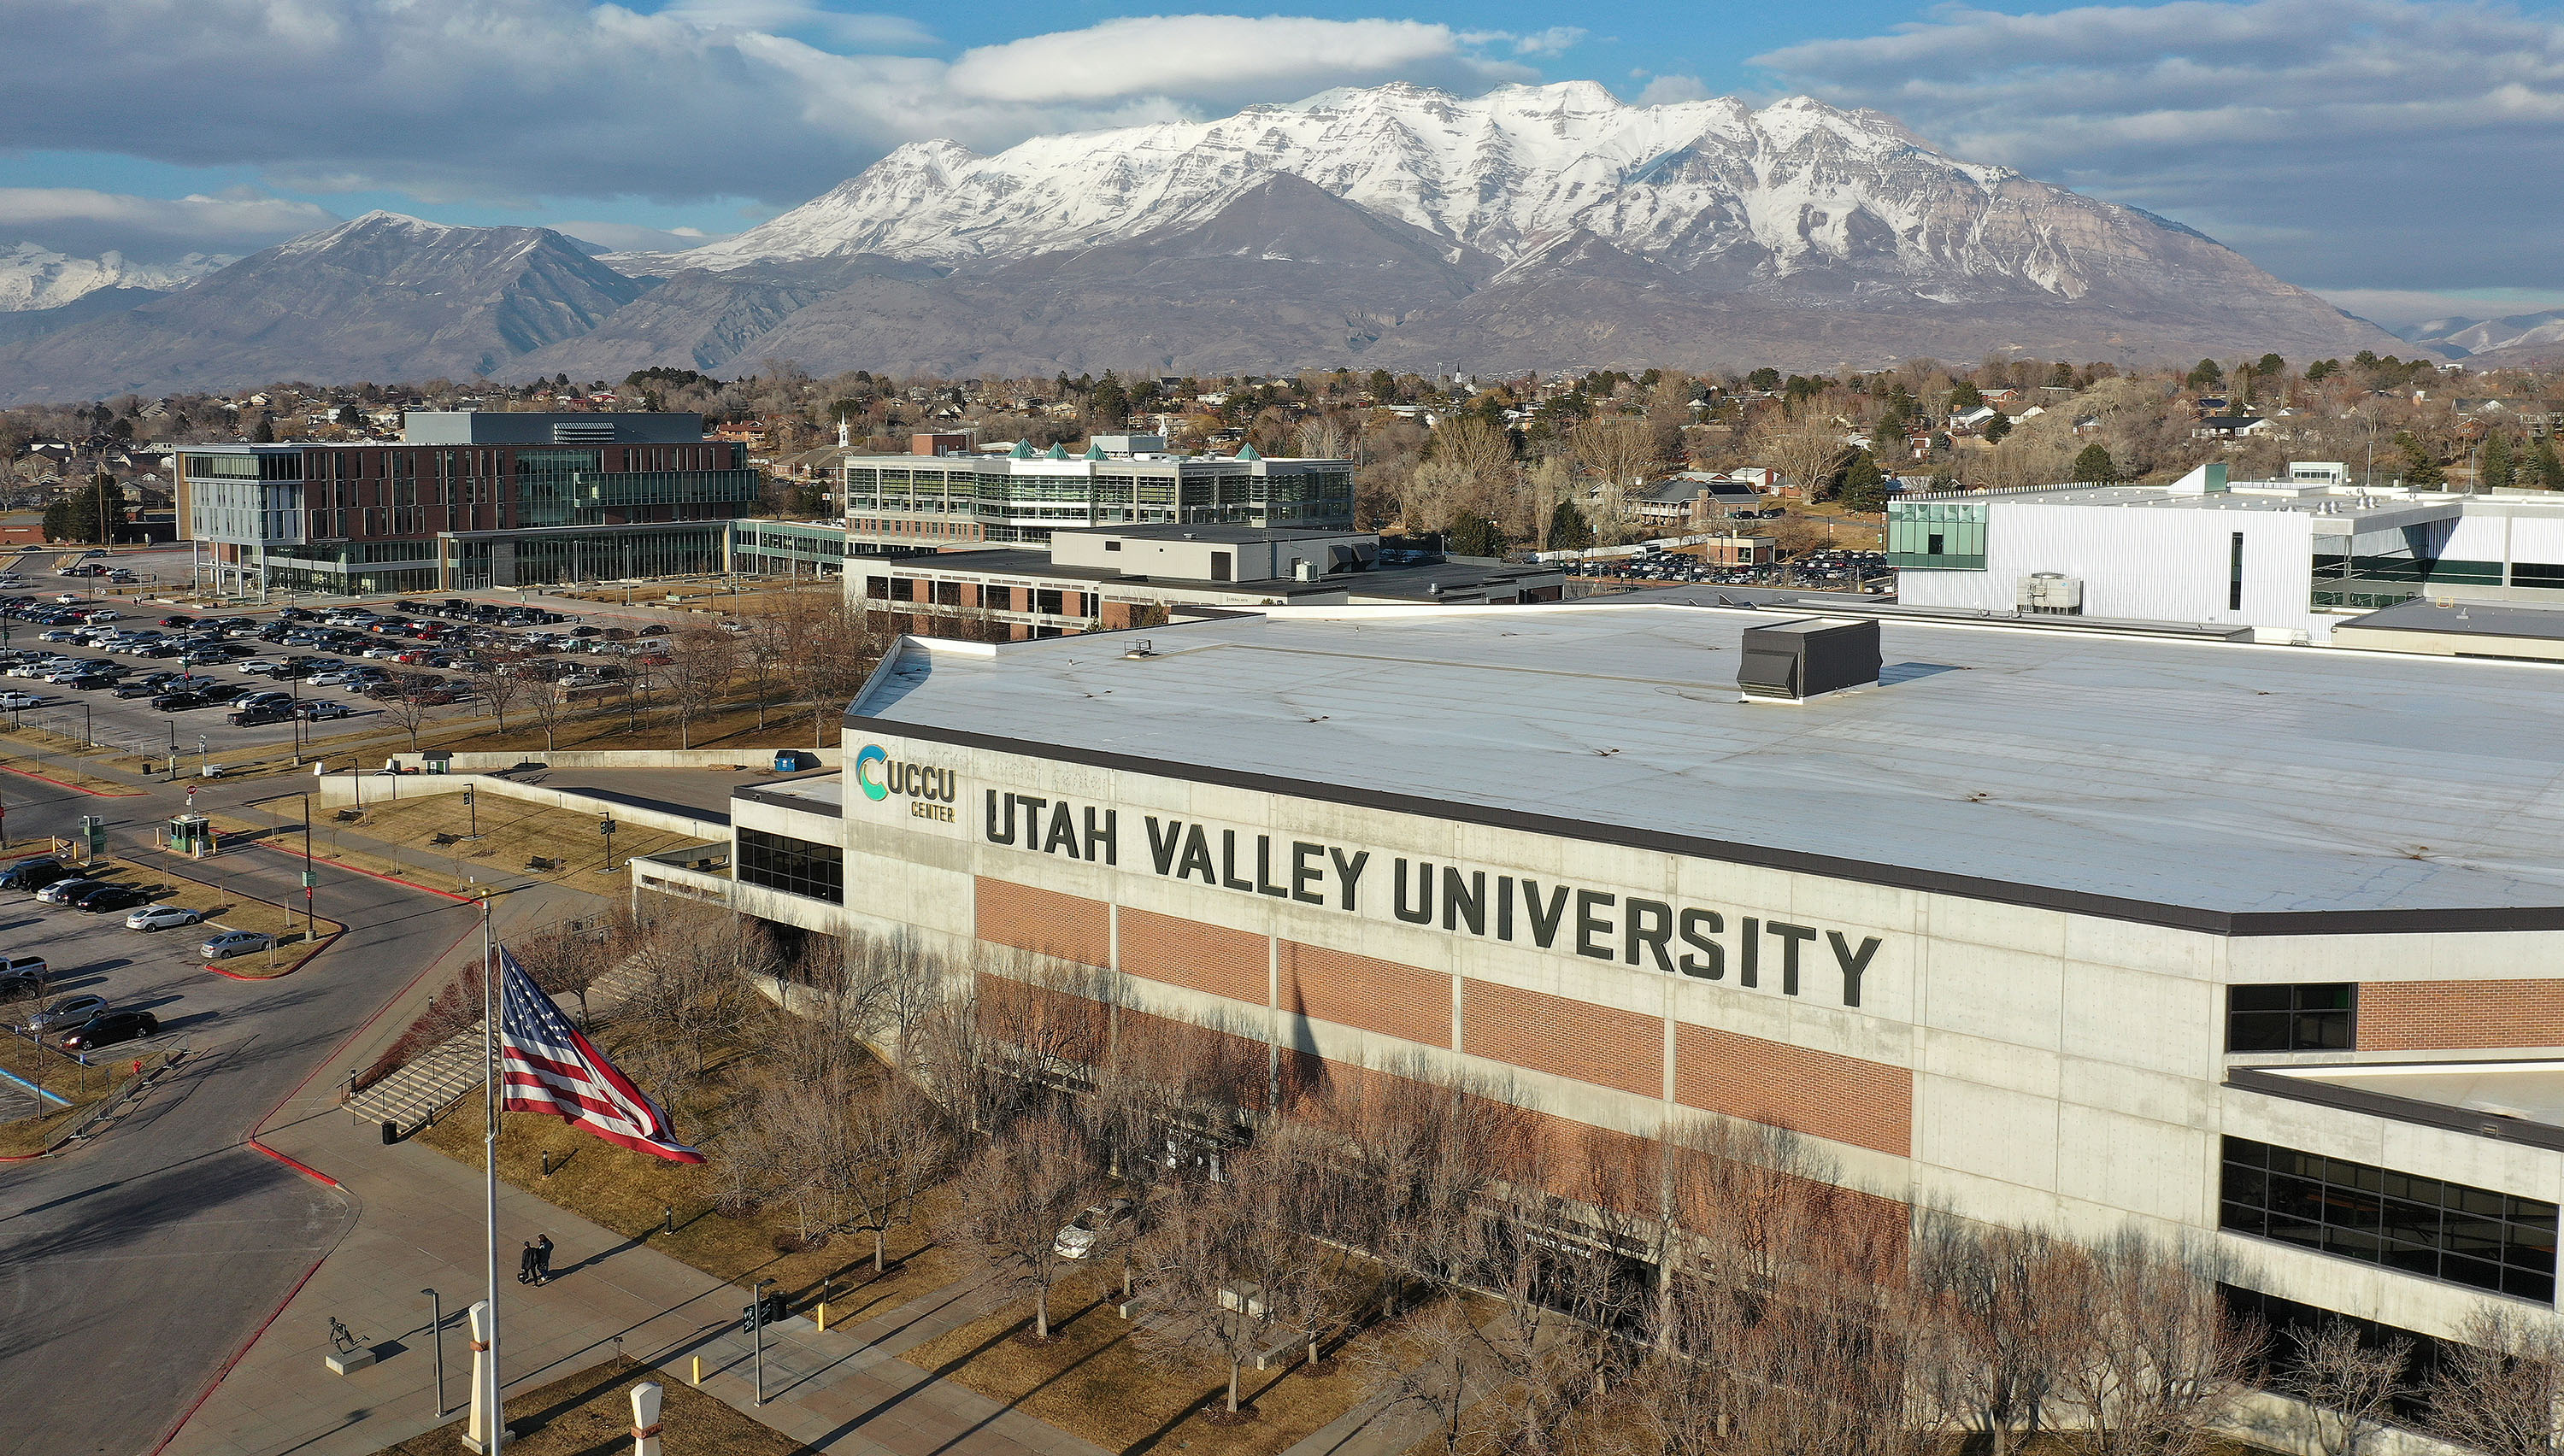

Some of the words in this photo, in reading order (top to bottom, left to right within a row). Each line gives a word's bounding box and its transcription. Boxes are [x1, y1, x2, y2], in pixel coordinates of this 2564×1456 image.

[887, 760, 956, 803] UCCU
[911, 801, 956, 824] CENTER
[985, 789, 1117, 866] UTAH
[1144, 814, 1370, 912] VALLEY
[1394, 857, 1884, 1009] UNIVERSITY
[1561, 1244, 1591, 1259] OFFICE
